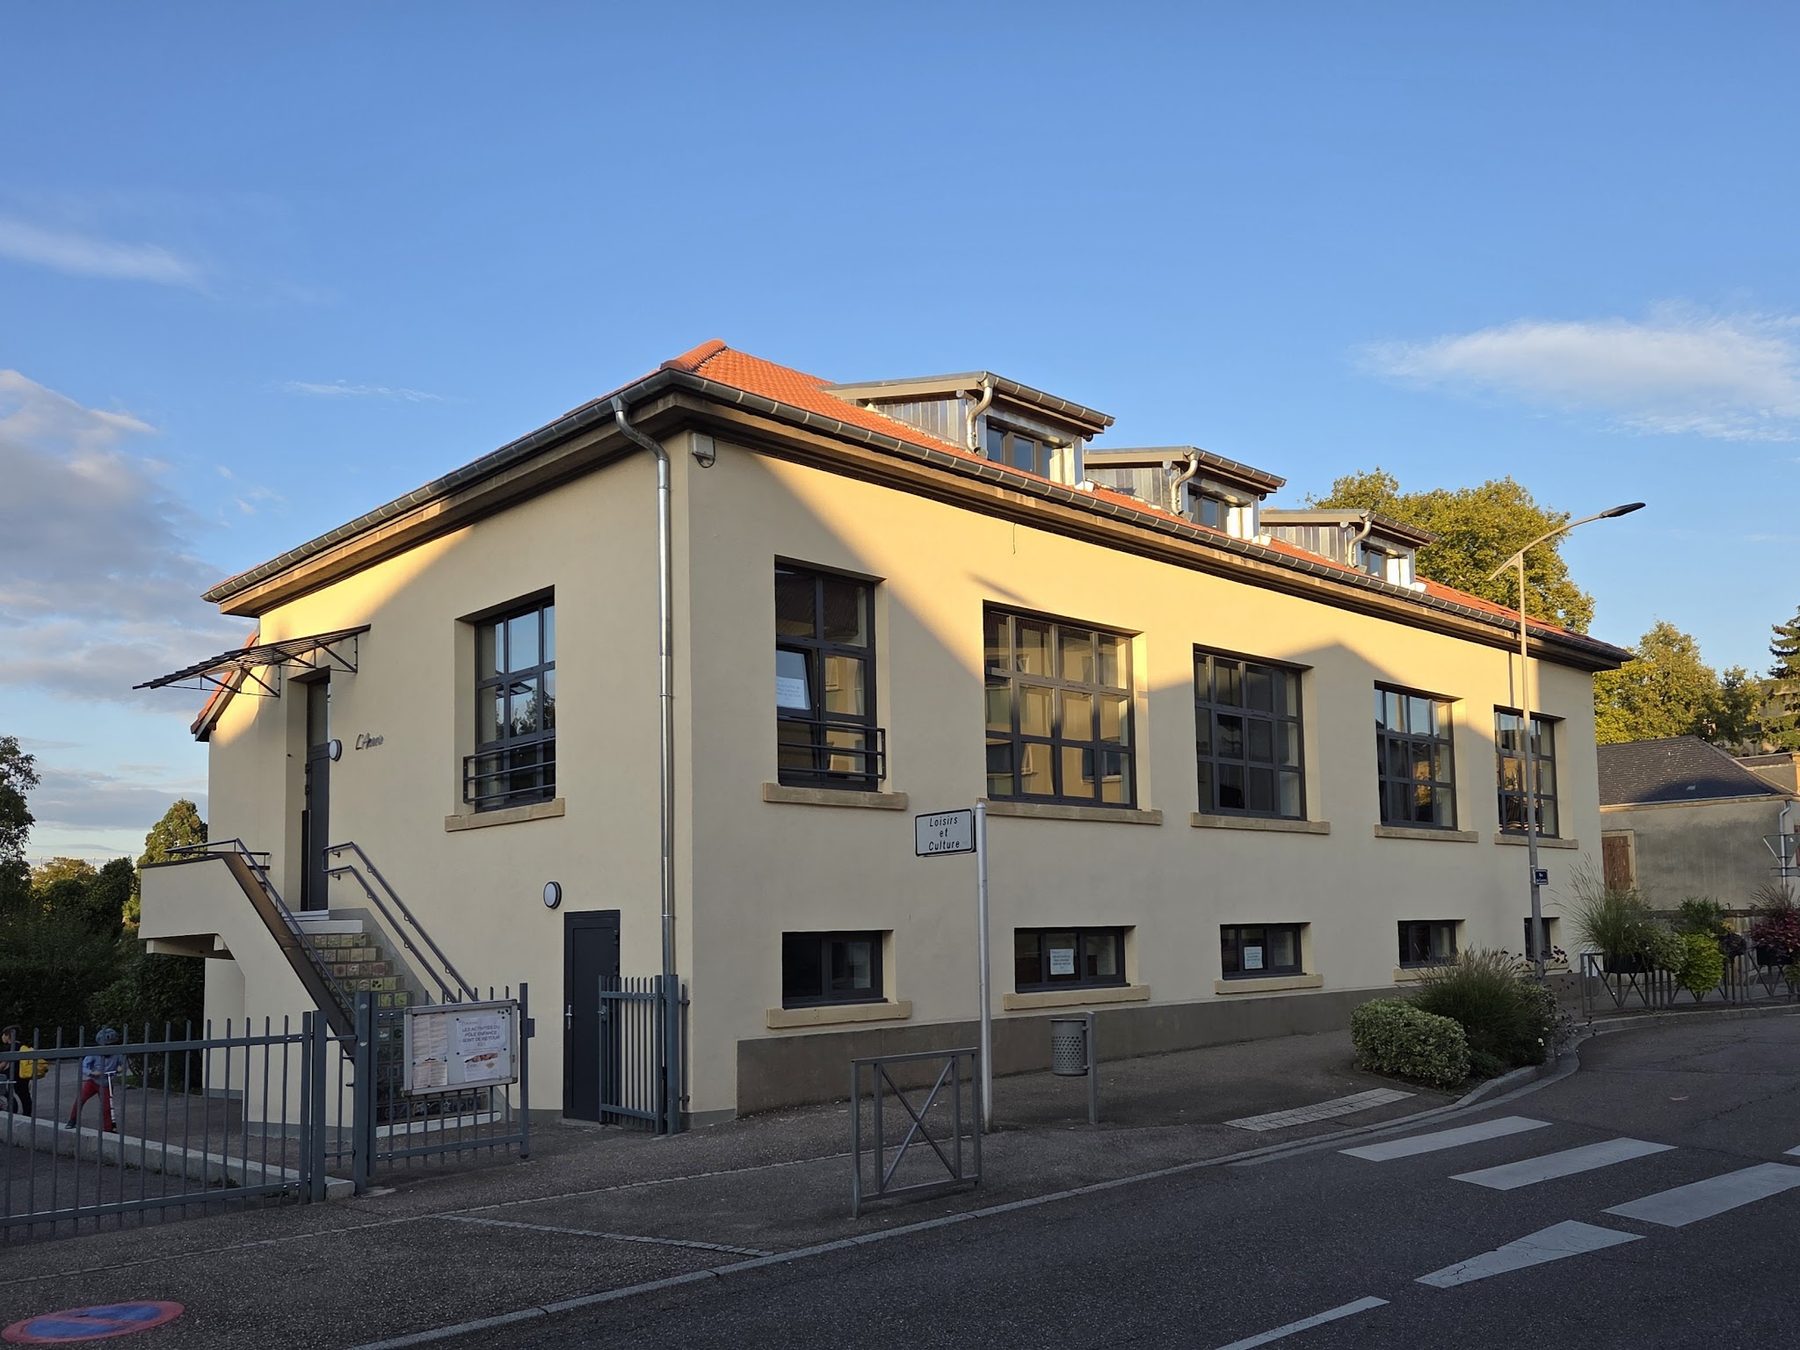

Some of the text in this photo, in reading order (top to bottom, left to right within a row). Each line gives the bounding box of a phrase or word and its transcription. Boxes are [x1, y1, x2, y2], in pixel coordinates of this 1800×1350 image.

[929, 816, 958, 827] Loisirs
[939, 828, 948, 837] et
[928, 840, 960, 851] Culture
